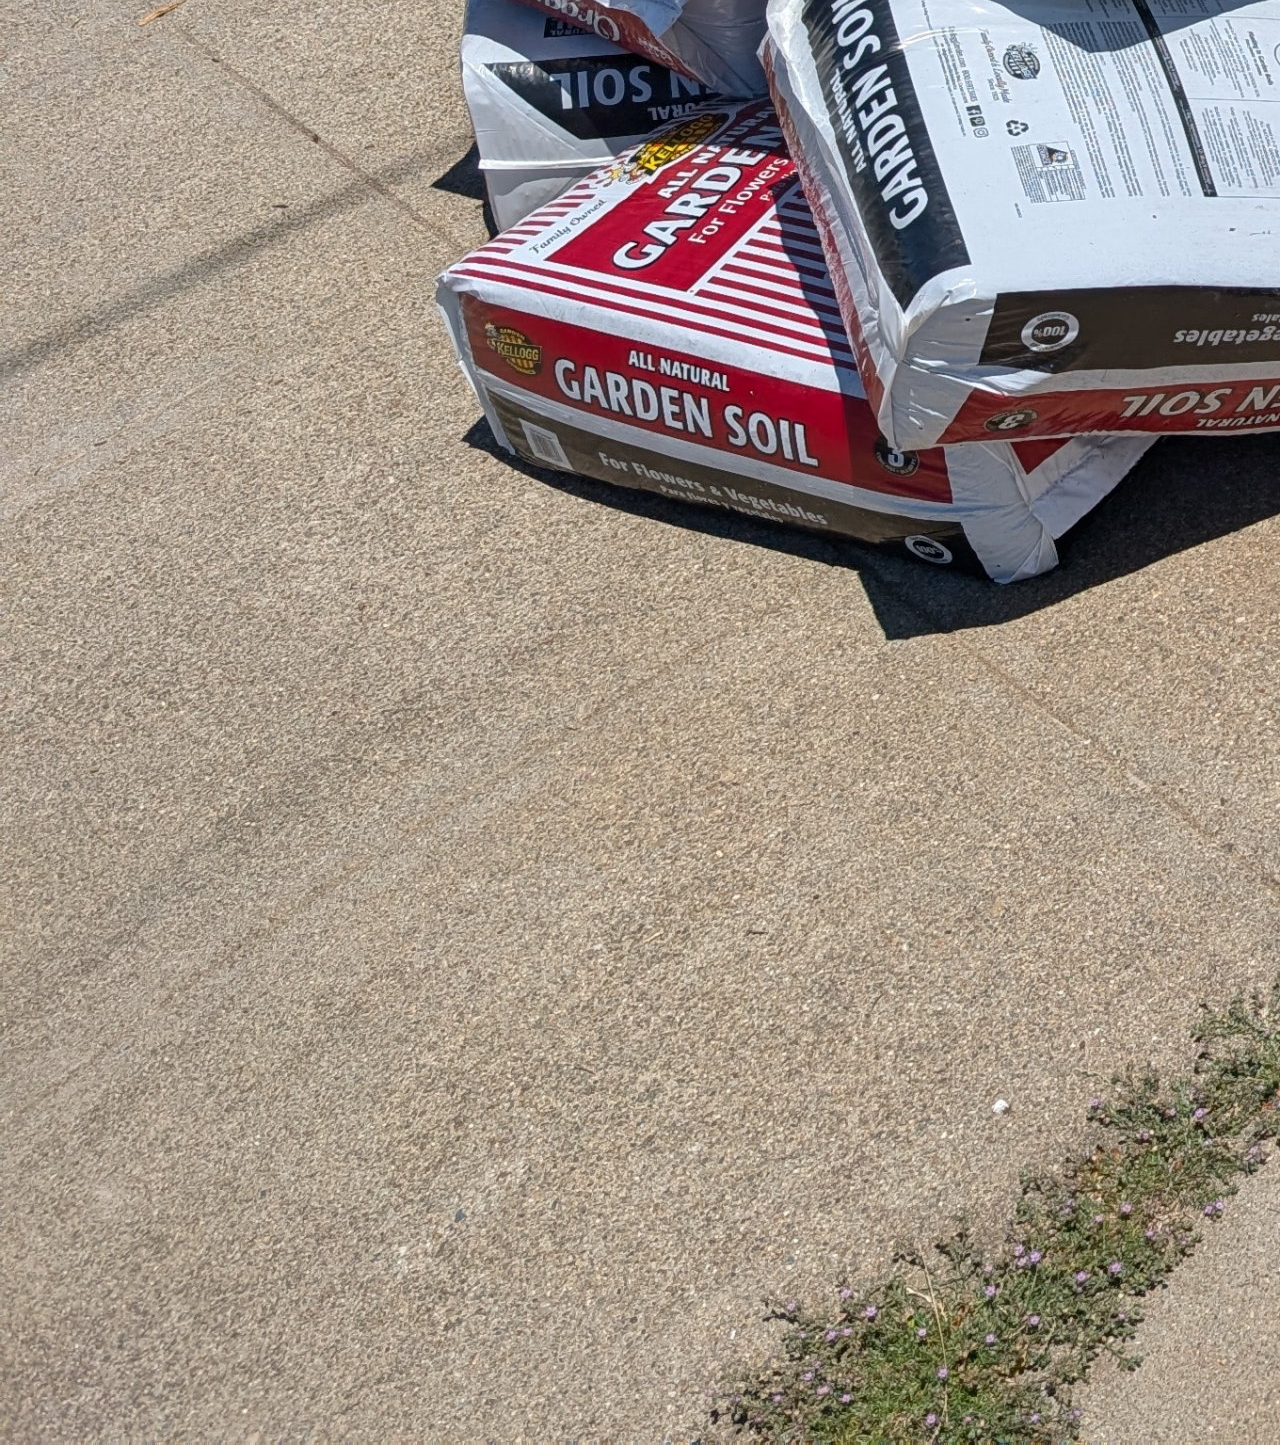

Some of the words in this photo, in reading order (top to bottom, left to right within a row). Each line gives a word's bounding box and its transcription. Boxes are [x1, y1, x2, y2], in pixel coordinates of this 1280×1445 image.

[550, 66, 652, 110] SOIL
[852, 64, 928, 230] GARDEN
[612, 126, 785, 270] GARDEN
[688, 217, 725, 244] For
[718, 158, 789, 214] Flowers
[528, 223, 572, 255] Family
[569, 199, 607, 226] Owned
[497, 343, 540, 361] KELLOGG
[629, 350, 656, 371] ALL
[659, 358, 730, 392] NATURAL
[555, 360, 713, 437] GARDEN
[724, 405, 818, 466] SOIL
[1120, 388, 1232, 419] SOIL
[1197, 413, 1279, 428] NATURAL
[599, 452, 629, 473] For
[632, 463, 705, 494] Flowers
[709, 483, 722, 497] &
[722, 486, 829, 526] Vegetables
